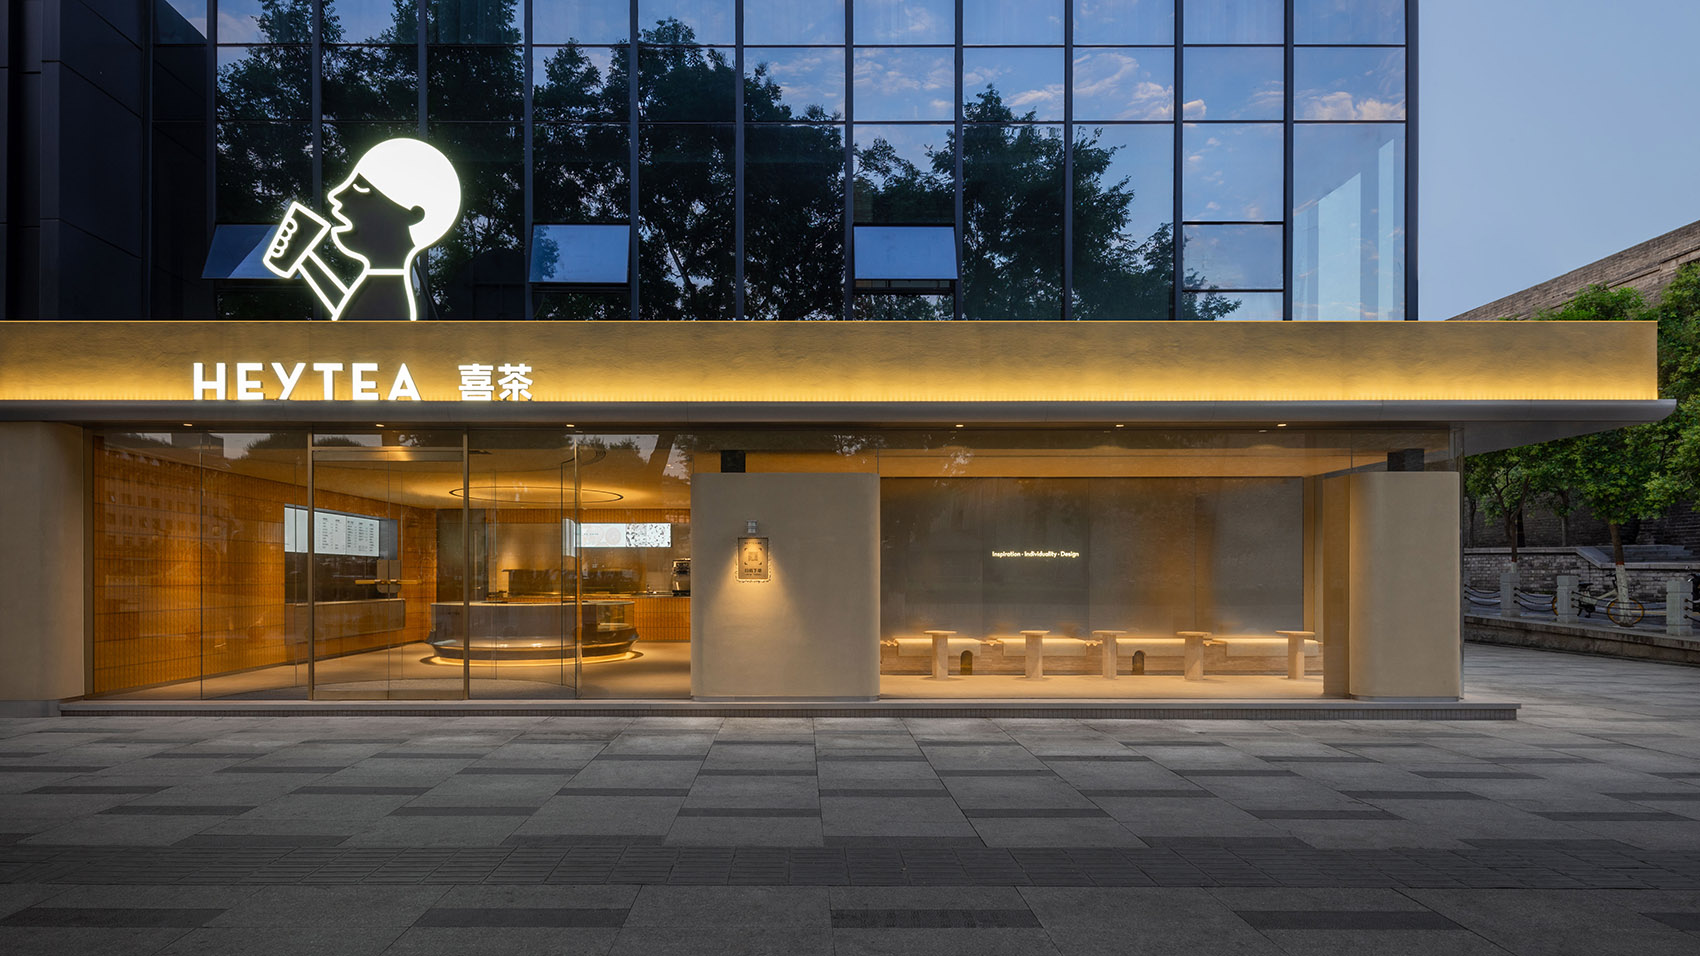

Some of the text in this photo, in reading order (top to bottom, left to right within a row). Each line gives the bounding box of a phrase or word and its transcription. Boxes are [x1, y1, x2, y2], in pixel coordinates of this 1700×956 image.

[193, 362, 534, 401] HEYTEA 喜茶
[991, 550, 1080, 558] Inspiration Individuality Design
